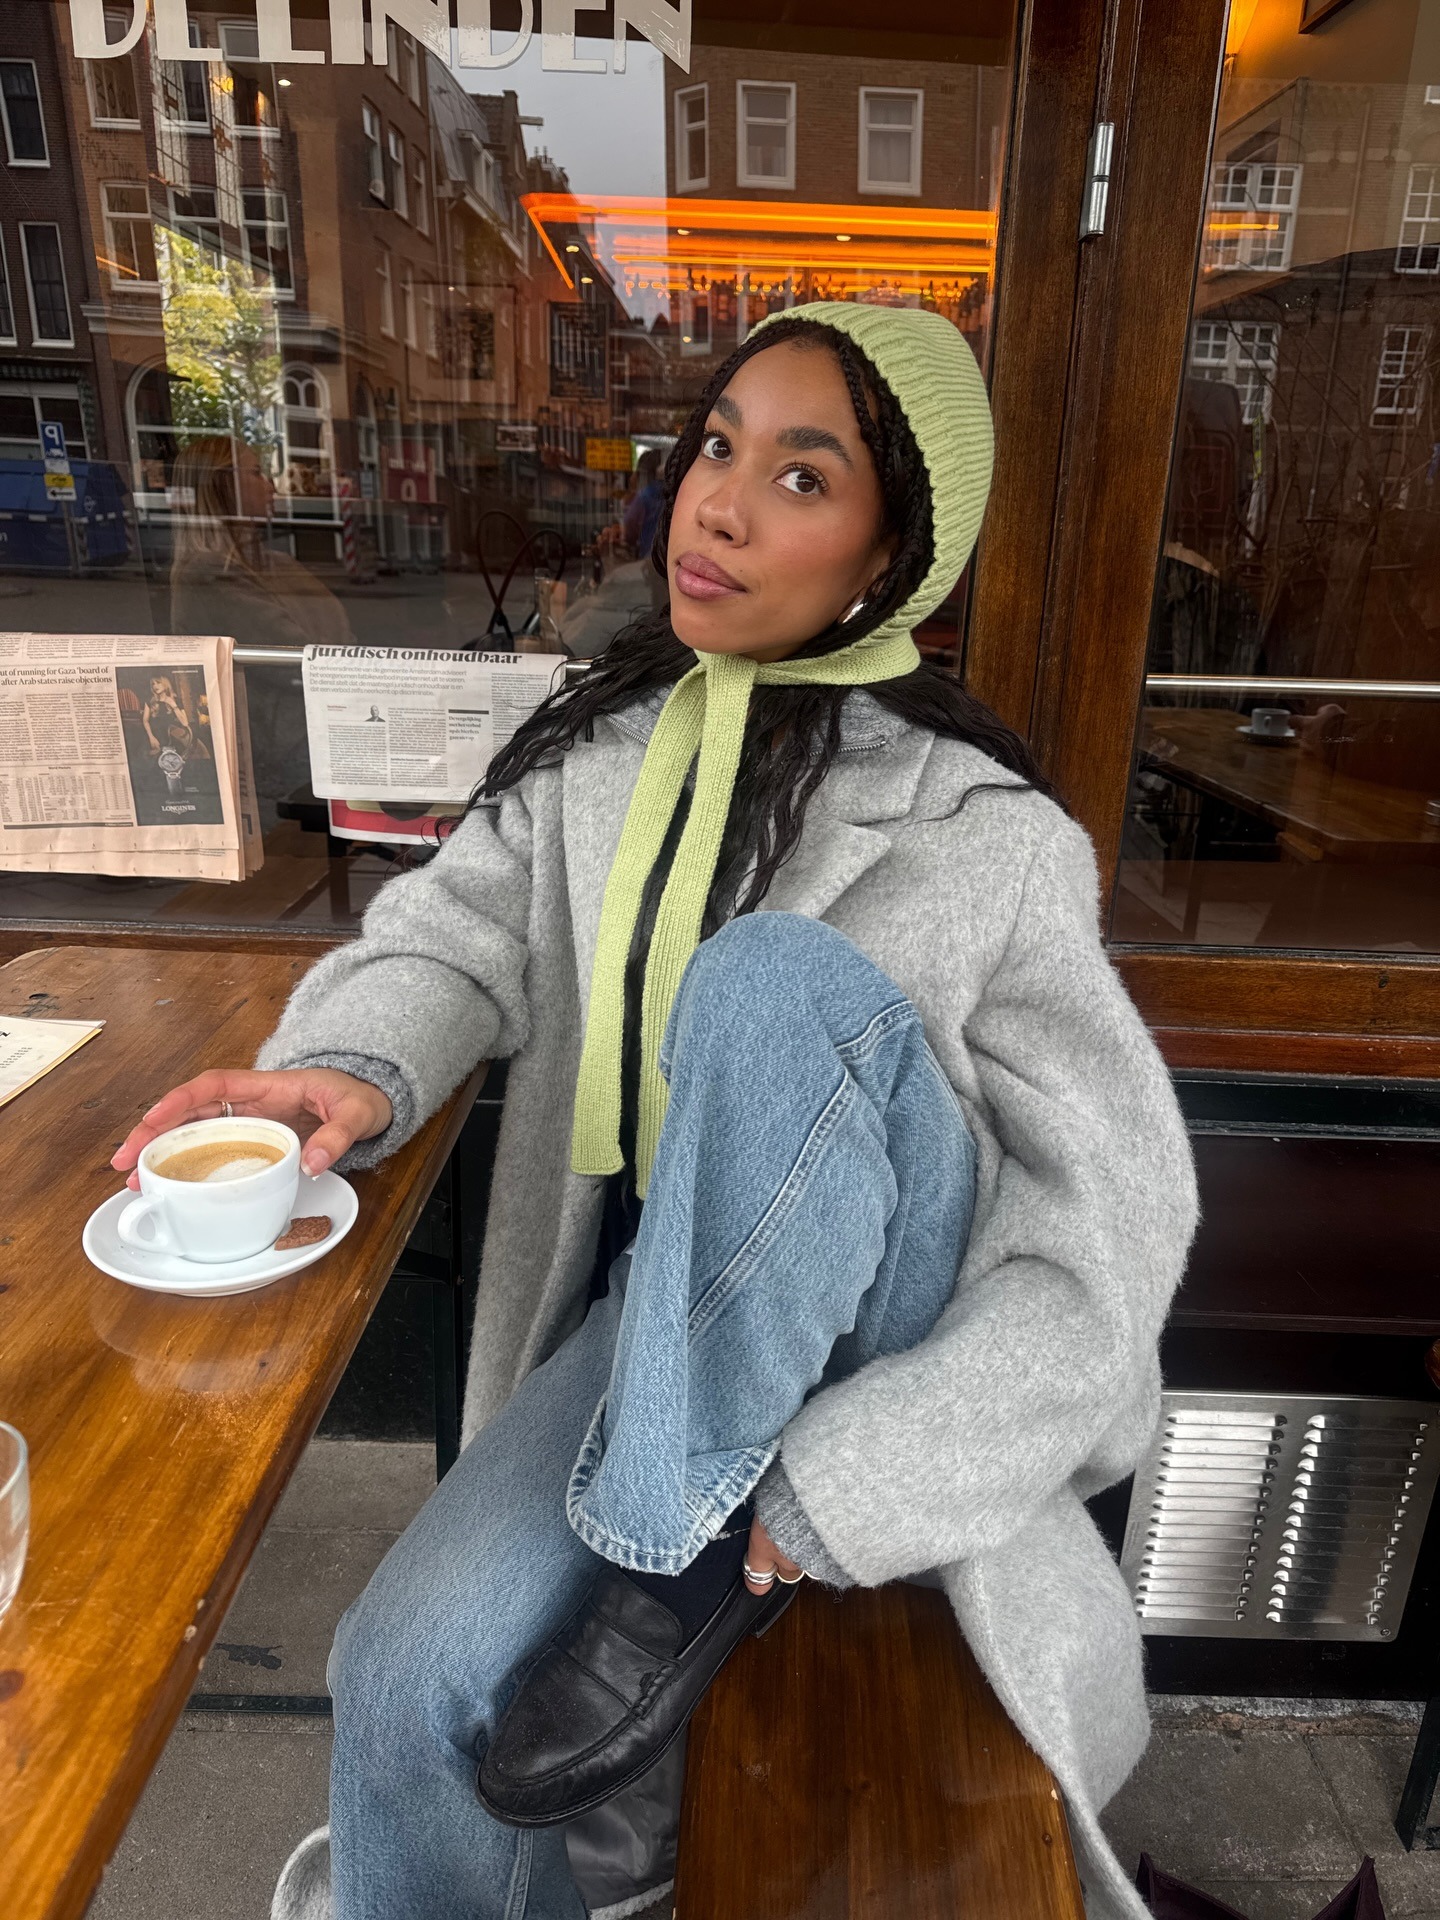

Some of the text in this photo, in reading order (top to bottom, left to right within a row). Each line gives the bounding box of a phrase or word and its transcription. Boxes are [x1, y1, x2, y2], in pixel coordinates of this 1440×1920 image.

[308, 645, 522, 664] juridisch onhoudbaar
[9, 668, 17, 676] of
[17, 667, 46, 677] running
[46, 667, 57, 675] for
[58, 667, 76, 675] Gaza
[101, 665, 109, 674] of
[1, 675, 113, 686] after Arab states raise objections
[161, 804, 196, 812] LONGINES
